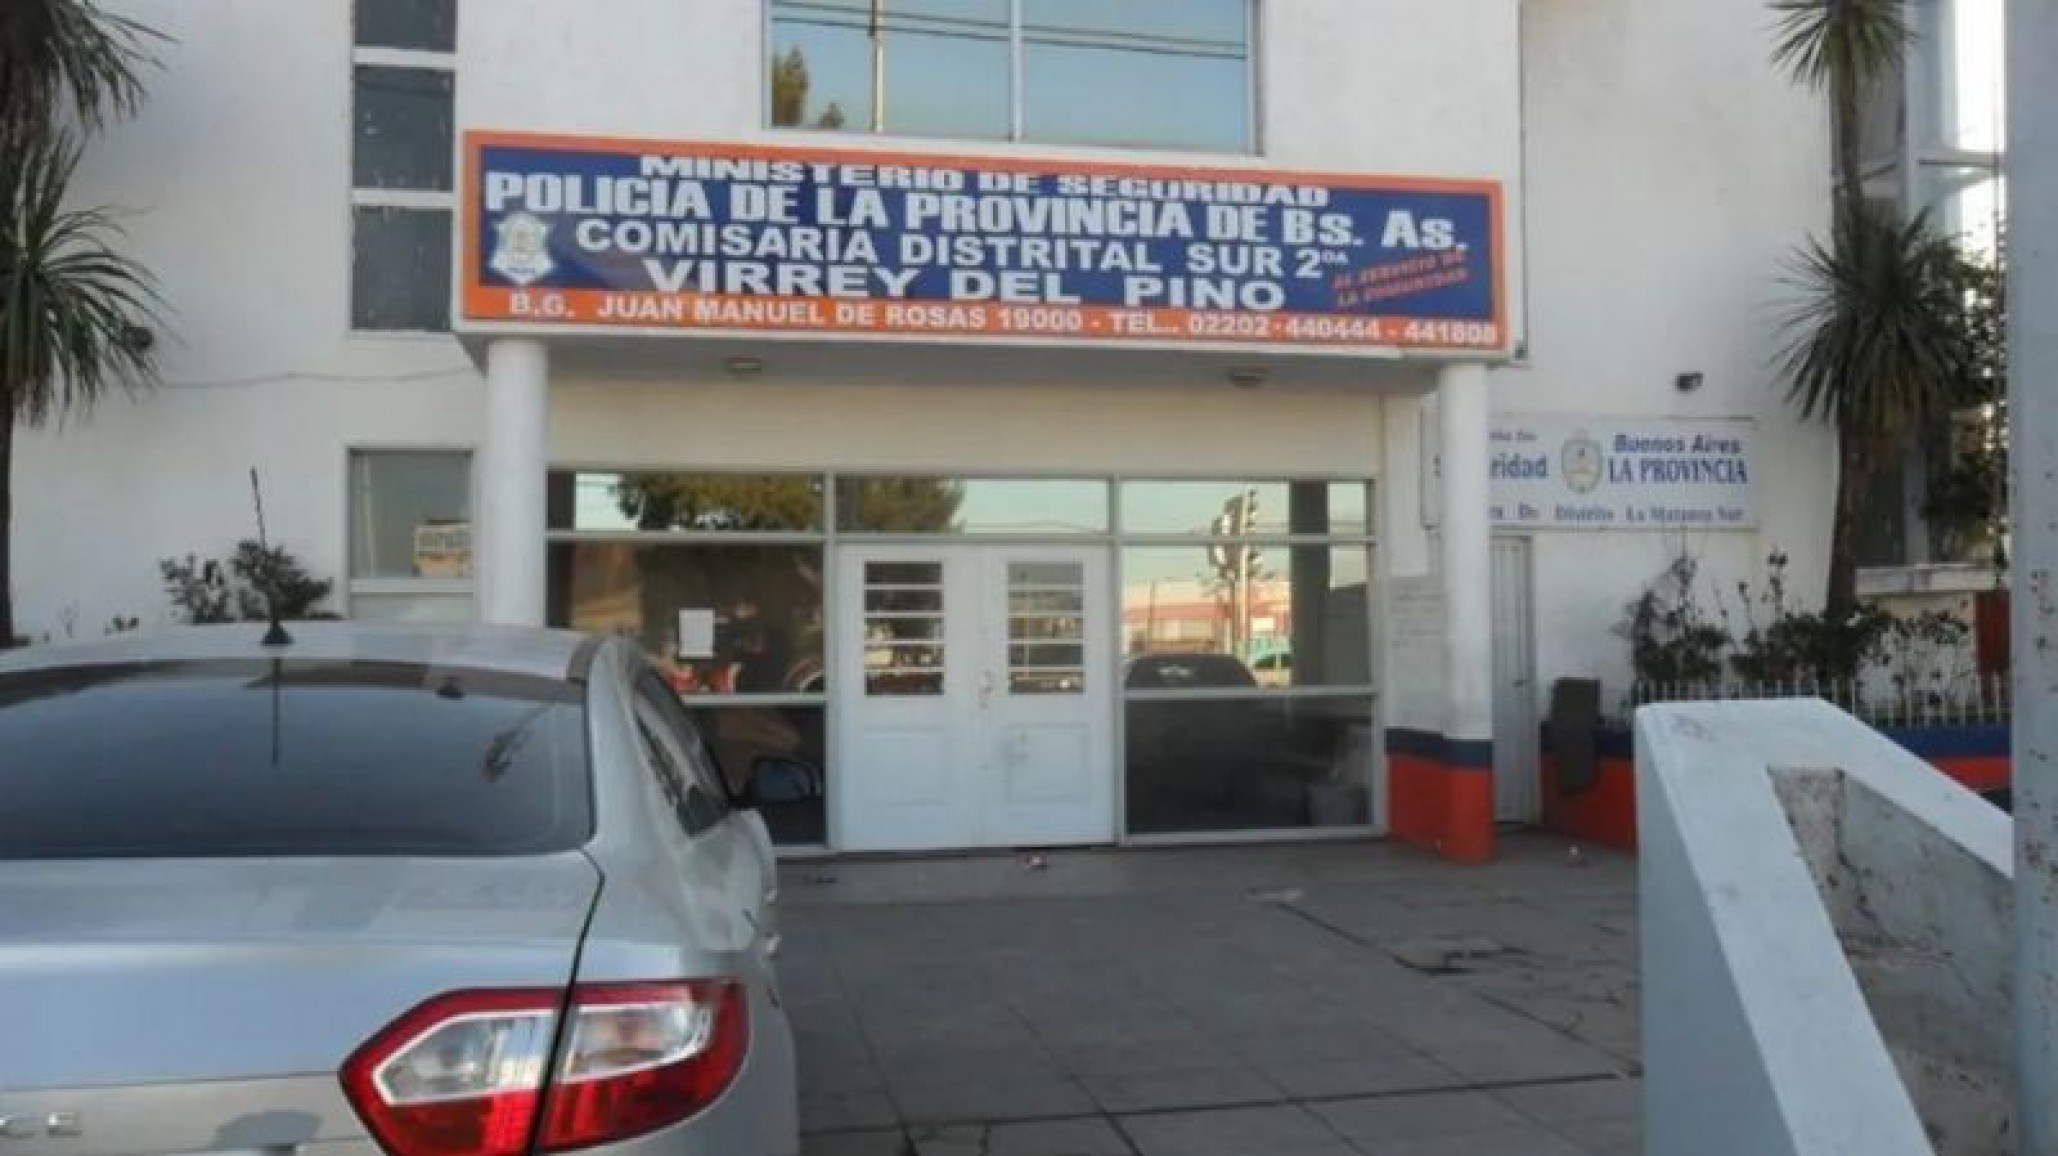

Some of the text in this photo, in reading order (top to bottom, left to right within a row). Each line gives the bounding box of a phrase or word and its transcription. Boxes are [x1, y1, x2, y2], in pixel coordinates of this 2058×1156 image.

[485, 170, 711, 219] POLICIA
[730, 182, 799, 225] DE
[816, 187, 889, 228] LA
[905, 192, 1194, 238] PROVINCIA
[1206, 205, 1268, 243] DE
[639, 155, 1329, 207] MINISTERIO DE SEGURIDAD
[575, 217, 879, 264] COMISARIA
[902, 233, 1162, 273] DISTRITAL
[1186, 241, 1284, 277] SUR
[641, 258, 1286, 311] VIRREY DEL PINO
[597, 294, 683, 318] JUAN
[693, 298, 826, 324] MANUEL
[835, 302, 876, 326] DE
[885, 304, 988, 328] ROSAS
[998, 307, 1084, 331] 19000
[1614, 433, 1740, 454] Buenos Aires
[1608, 457, 1748, 484] LA PROVINCIA
